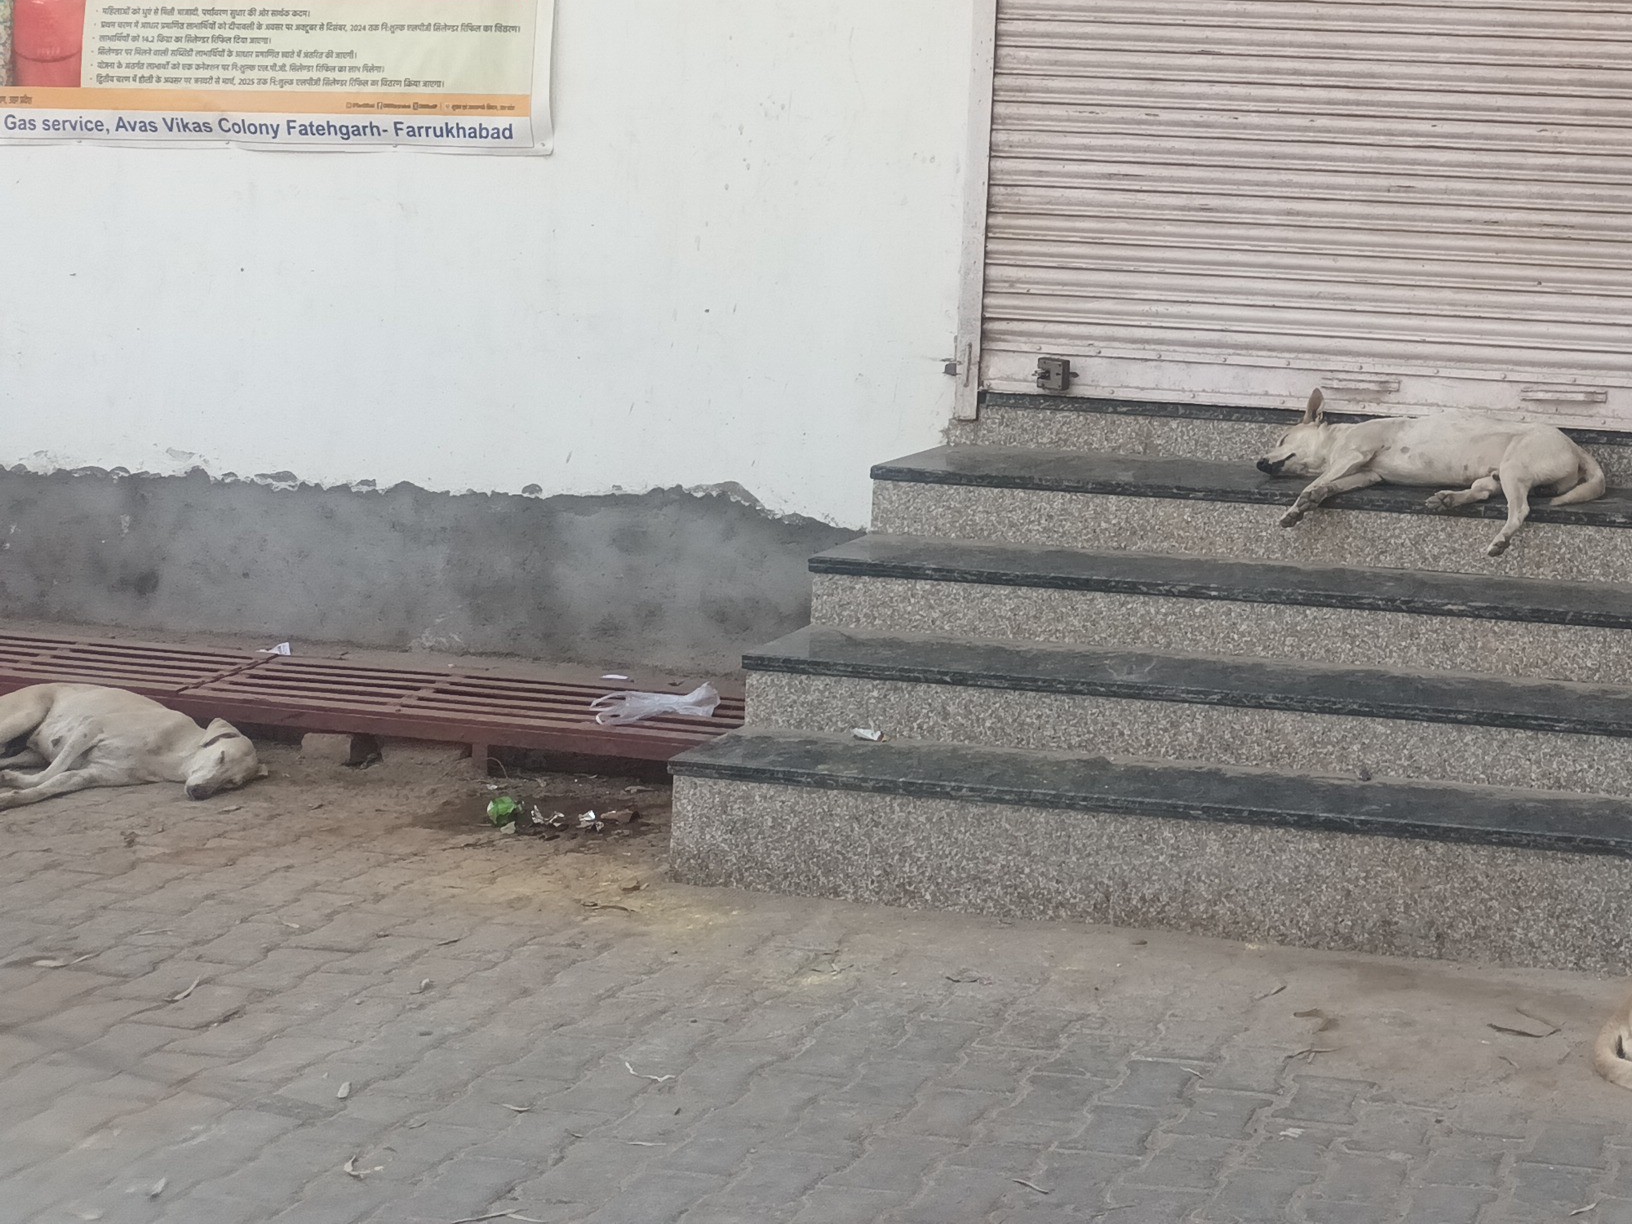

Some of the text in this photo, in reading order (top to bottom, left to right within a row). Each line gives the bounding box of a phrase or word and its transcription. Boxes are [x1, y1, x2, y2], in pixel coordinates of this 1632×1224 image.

[4, 114, 35, 130] Gas
[42, 116, 108, 133] service,
[115, 116, 157, 132] Avas
[162, 117, 212, 132] Vikas
[218, 118, 278, 138] Colony
[393, 122, 512, 138] Farrukhabad
